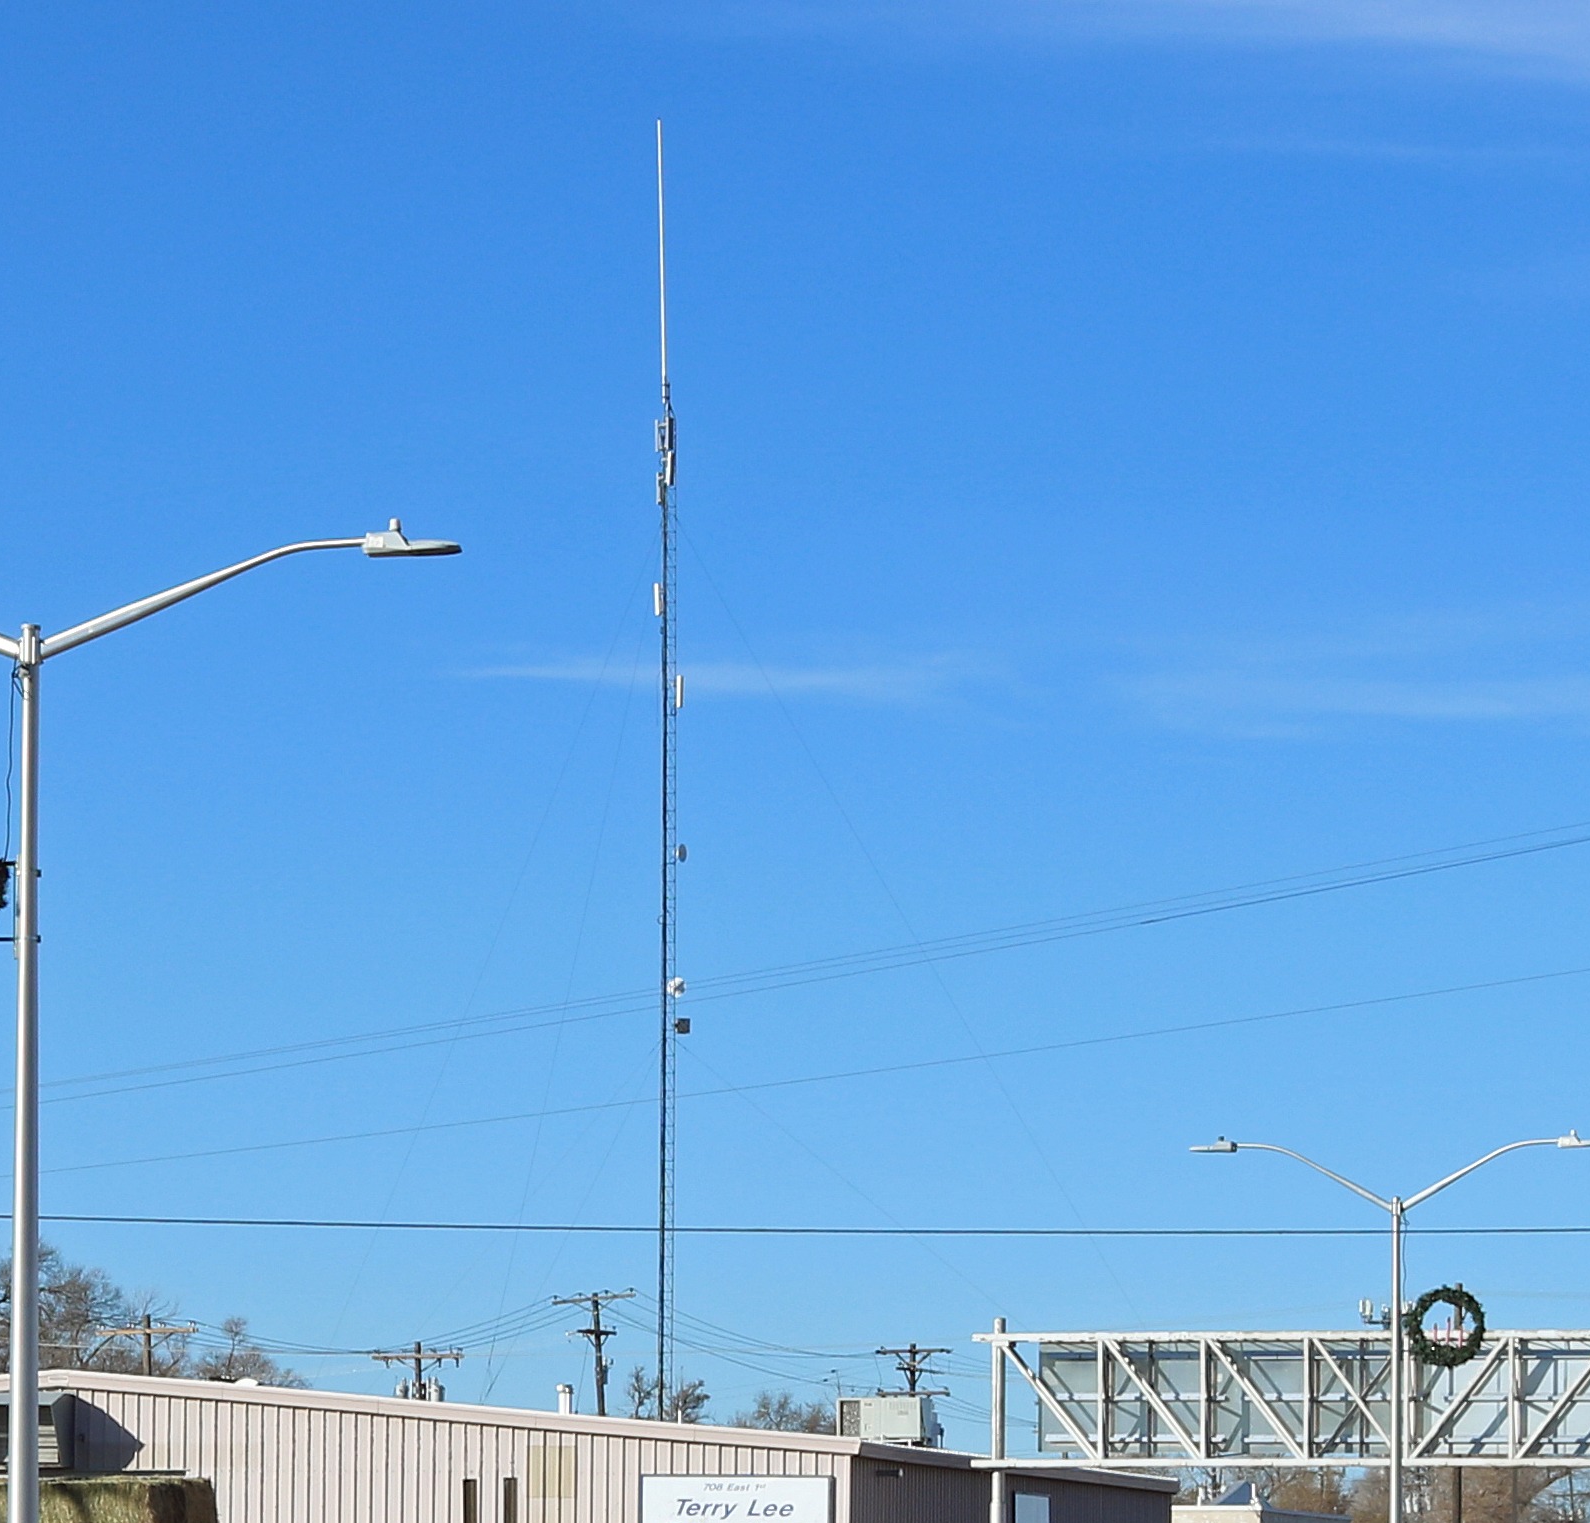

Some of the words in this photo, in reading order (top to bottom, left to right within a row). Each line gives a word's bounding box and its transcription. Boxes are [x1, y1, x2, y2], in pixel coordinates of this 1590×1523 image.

[703, 1483, 723, 1491] 708
[726, 1483, 750, 1492] East
[676, 1498, 738, 1520] Terry
[747, 1499, 795, 1517] Lee
